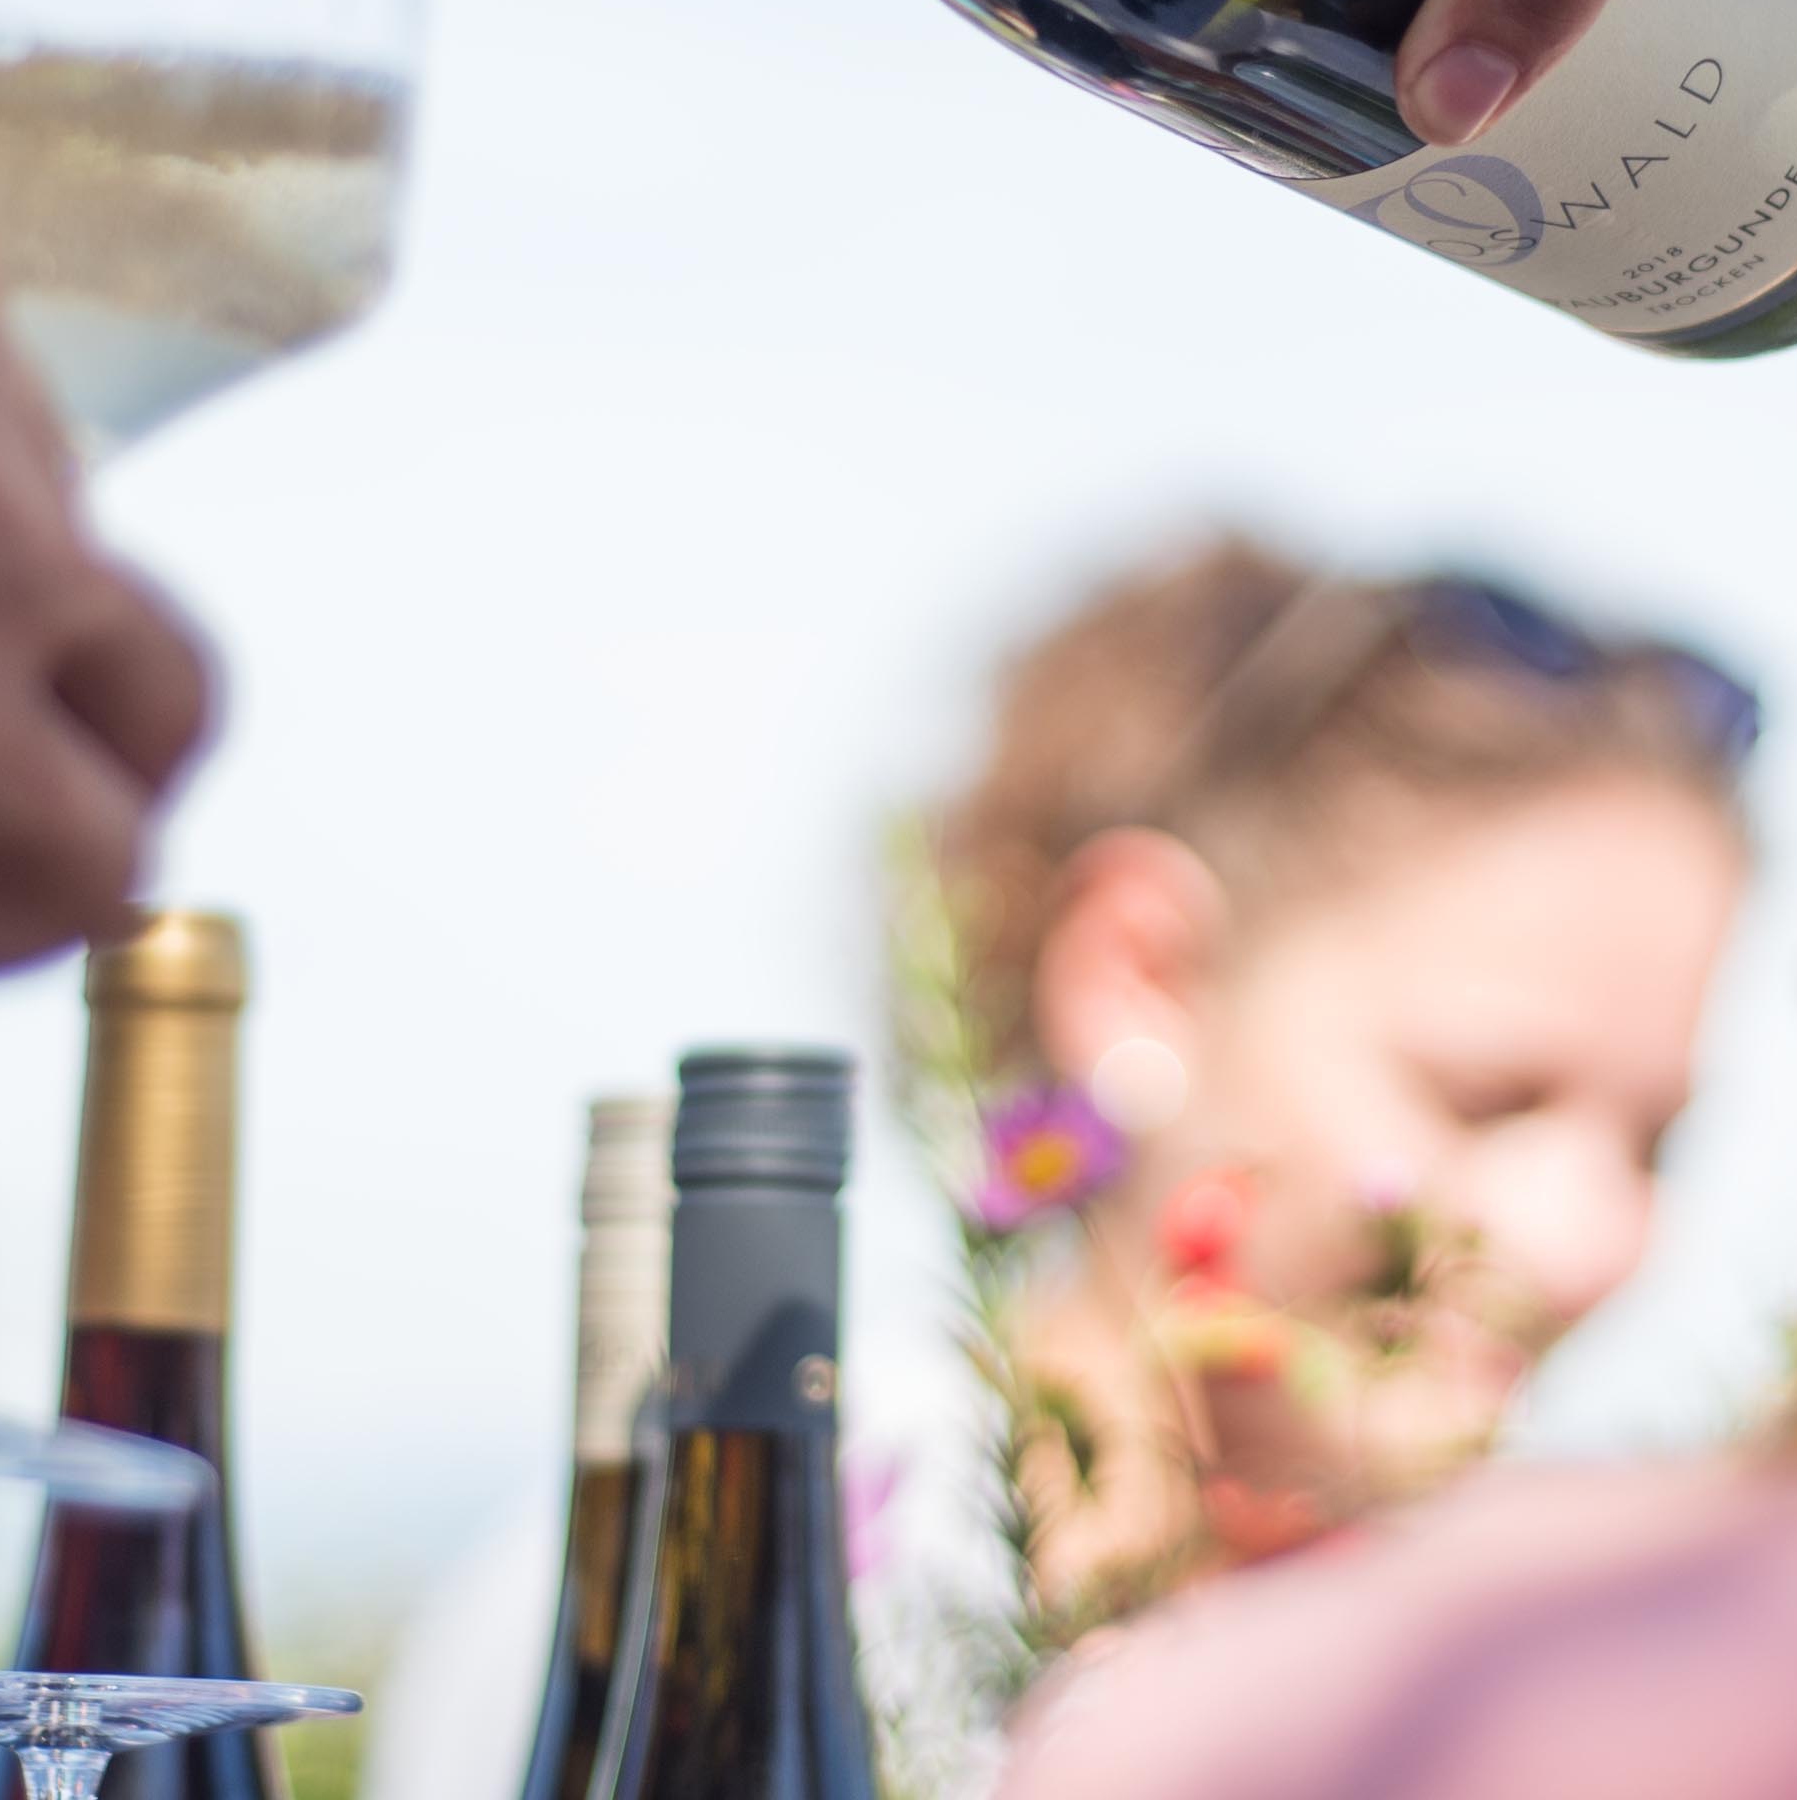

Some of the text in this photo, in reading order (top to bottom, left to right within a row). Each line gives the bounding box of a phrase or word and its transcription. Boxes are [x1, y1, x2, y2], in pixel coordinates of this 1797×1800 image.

[1426, 58, 1724, 258] OSWALD
[1622, 246, 1682, 280] 2018
[1645, 254, 1765, 314] TROCKEN
